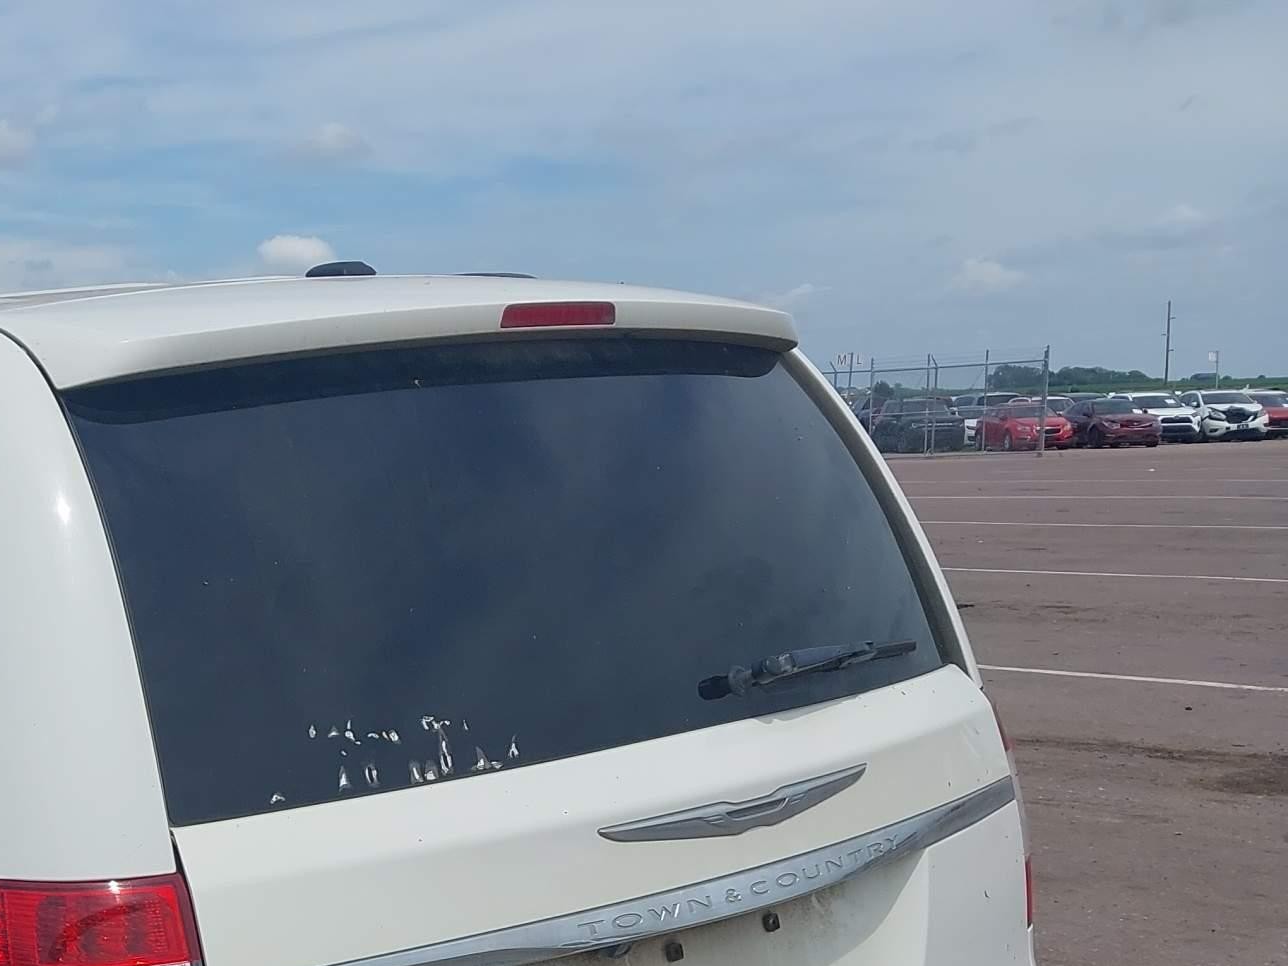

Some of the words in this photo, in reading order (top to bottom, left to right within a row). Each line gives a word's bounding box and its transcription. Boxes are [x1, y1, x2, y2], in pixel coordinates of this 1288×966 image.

[576, 895, 712, 937] TOWN
[725, 887, 743, 903] &
[750, 833, 899, 895] COUNTRY
